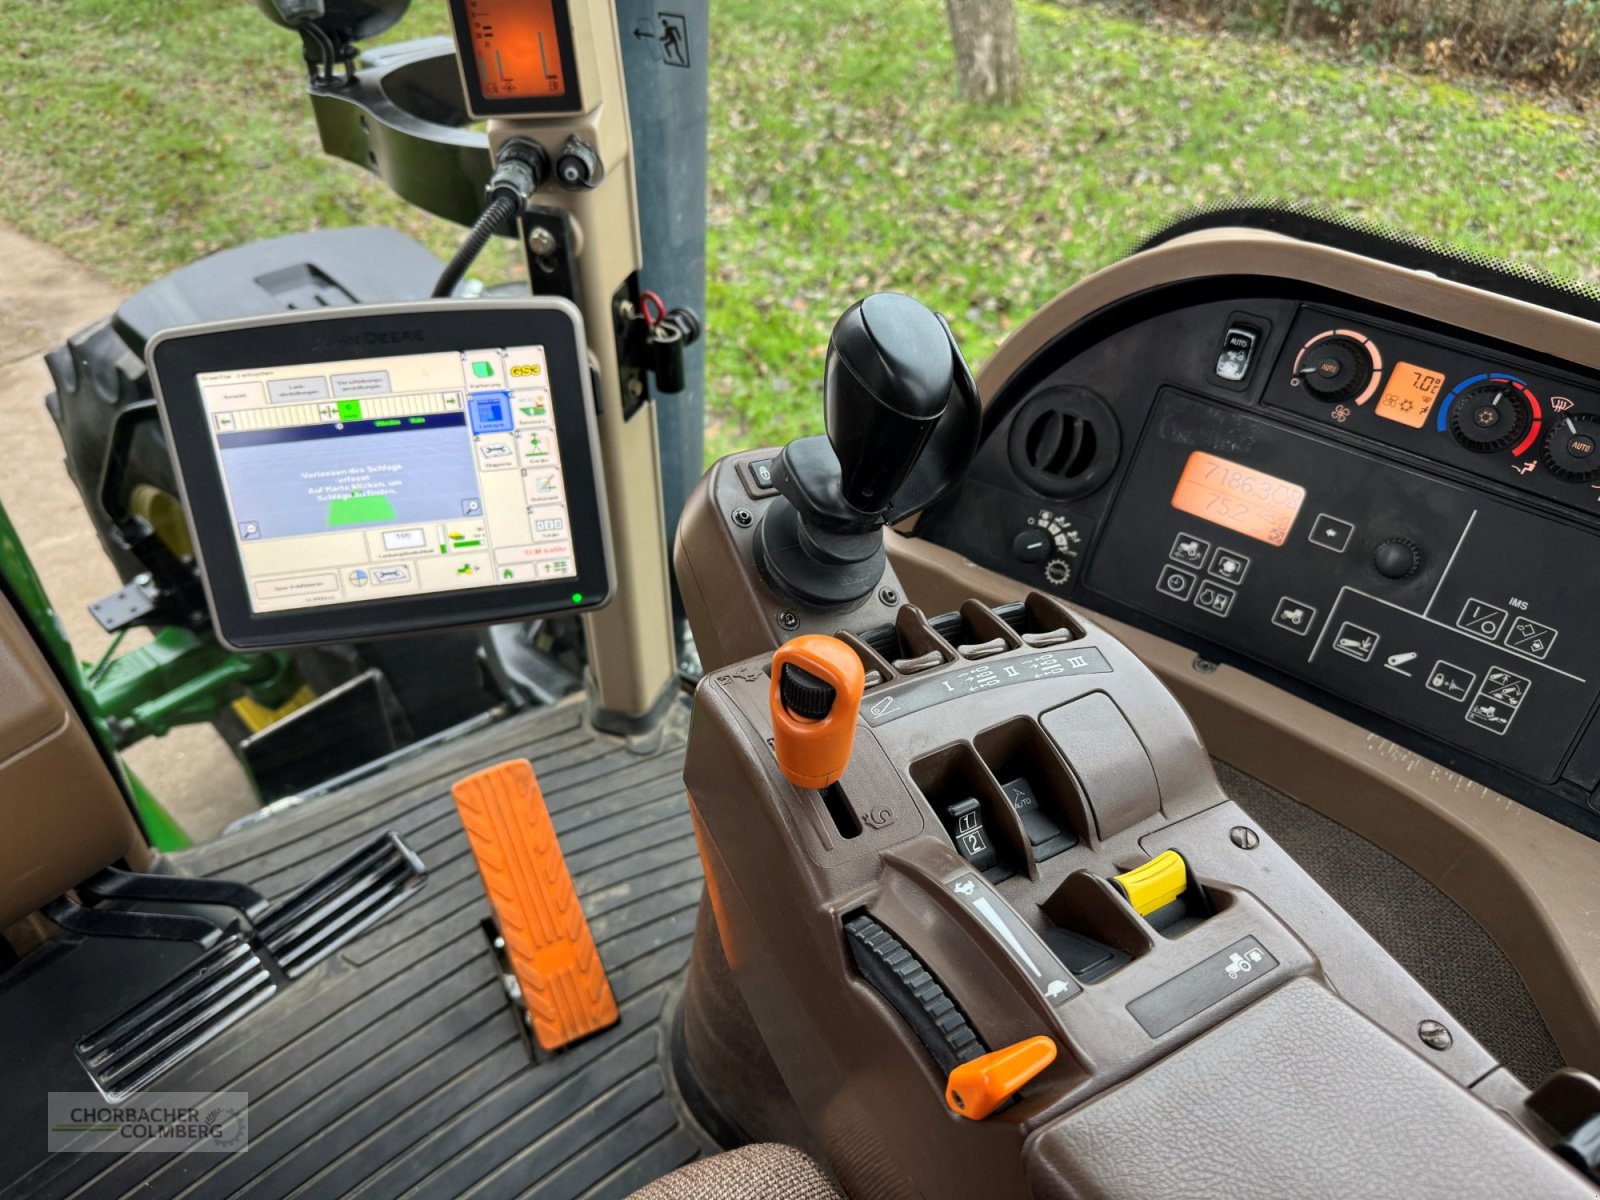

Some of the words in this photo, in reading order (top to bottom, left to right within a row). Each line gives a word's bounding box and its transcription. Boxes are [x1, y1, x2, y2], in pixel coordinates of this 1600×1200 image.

[1230, 338, 1247, 348] AUTO
[1571, 441, 1591, 453] AUTO
[1508, 596, 1529, 611] IMS
